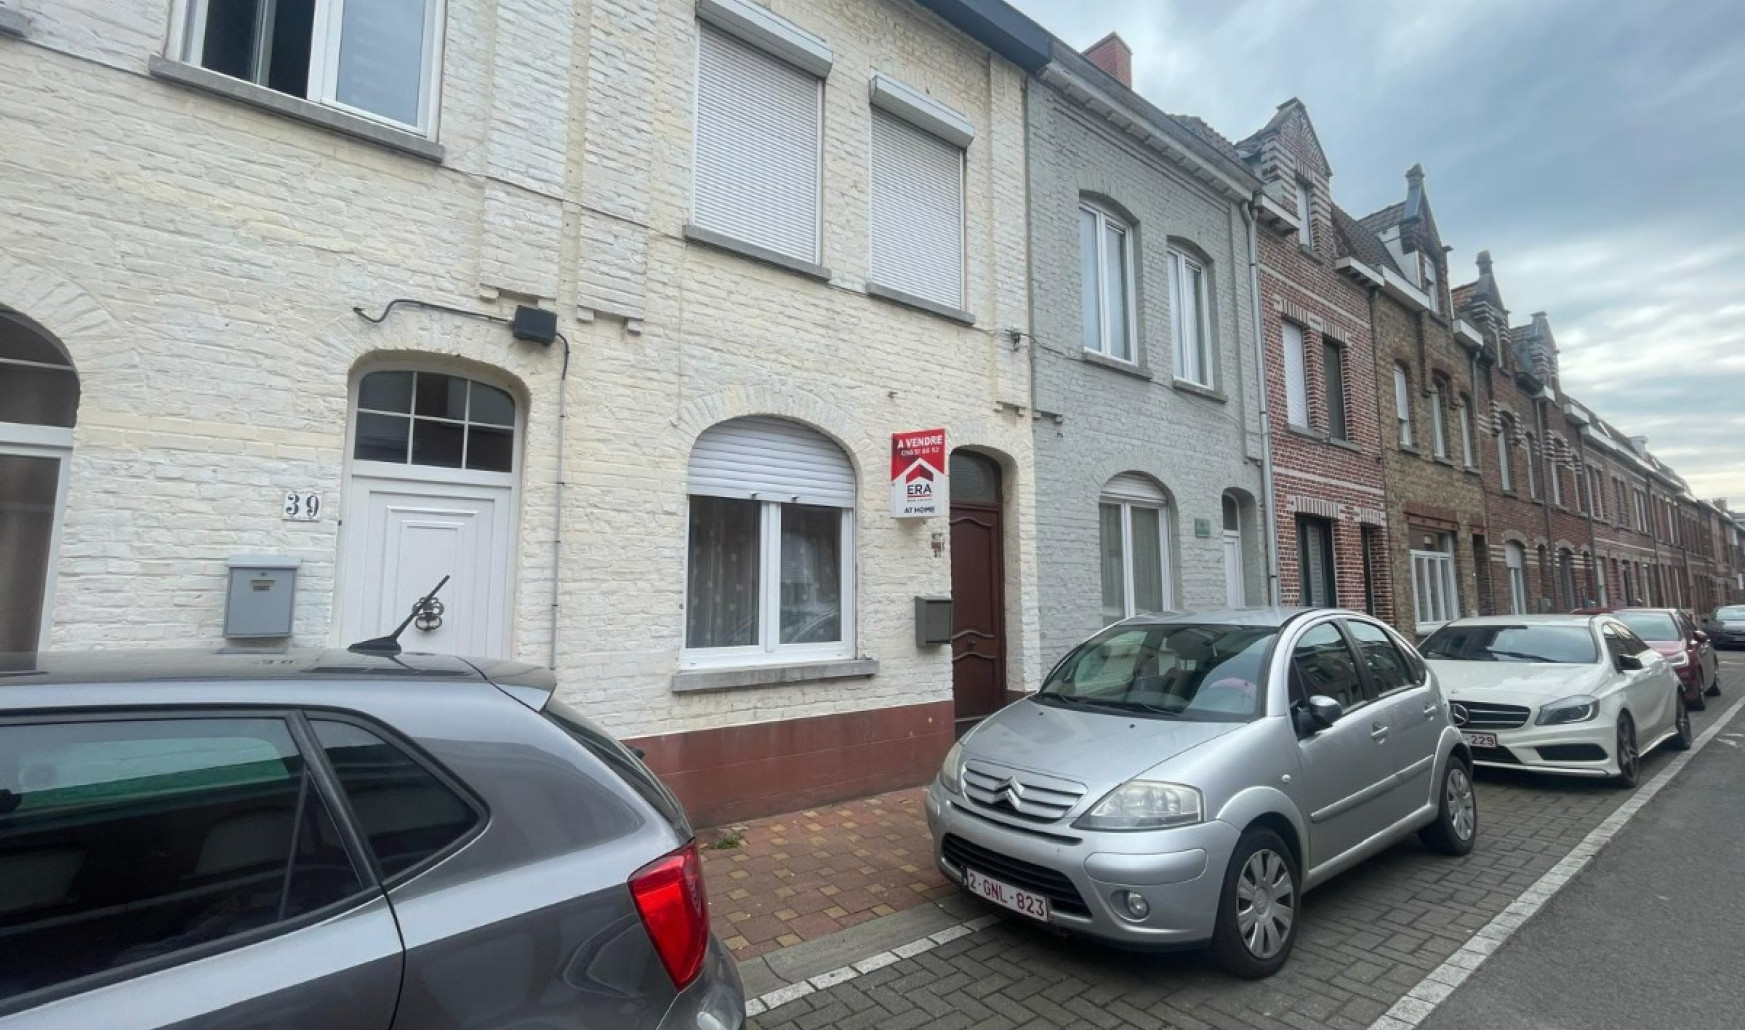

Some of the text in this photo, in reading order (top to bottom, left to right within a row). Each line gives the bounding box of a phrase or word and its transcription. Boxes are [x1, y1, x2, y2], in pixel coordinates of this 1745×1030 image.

[897, 435, 943, 449] A VENDRE
[907, 484, 932, 494] ERA
[285, 493, 320, 517] 39
